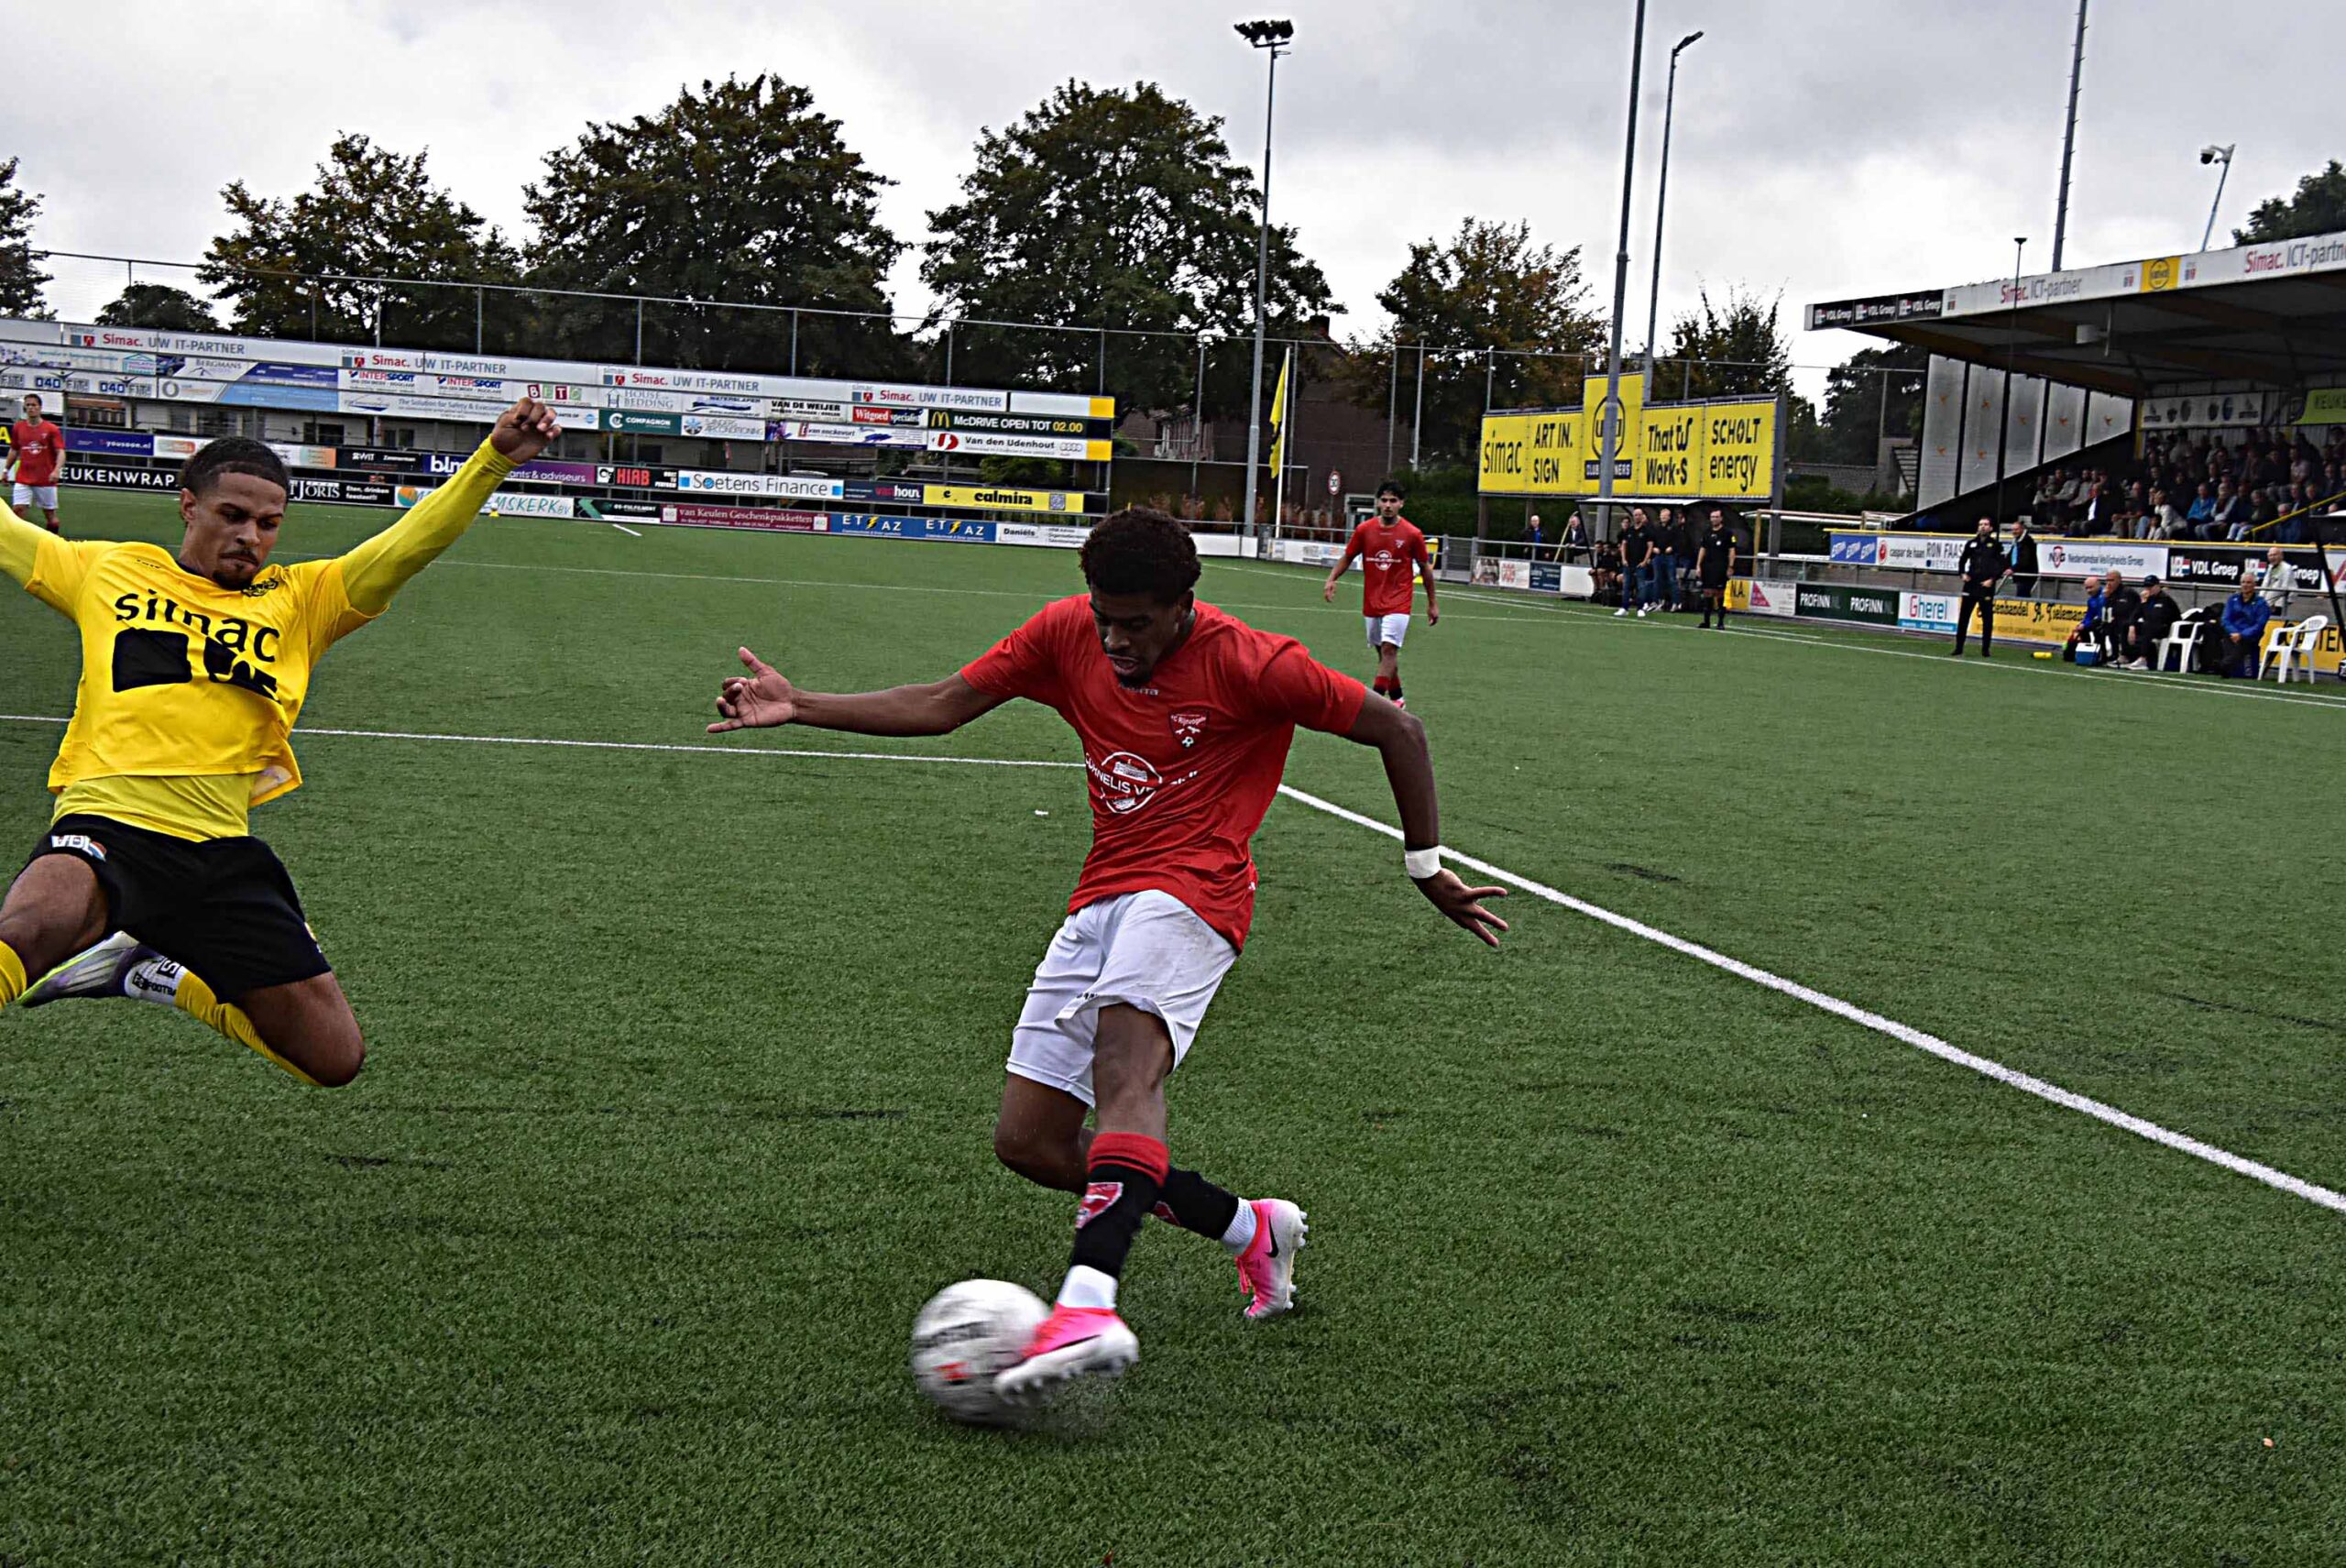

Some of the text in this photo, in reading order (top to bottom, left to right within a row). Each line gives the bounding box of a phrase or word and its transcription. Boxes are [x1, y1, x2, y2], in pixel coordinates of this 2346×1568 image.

[2030, 278, 2082, 301] ICT-partner
[103, 334, 246, 355] Simac. UW IT-PARTNER
[195, 358, 242, 370] BERGMANS
[372, 354, 507, 375] Simac. UW IT-PARTNER
[358, 370, 415, 383] INTERSPORT
[446, 377, 502, 389] INTERSPORT
[631, 372, 760, 392] Simac. UW IT-PARTNER
[623, 398, 674, 410] BEDDING
[771, 400, 791, 409] VAN
[806, 403, 841, 411] WEIJER
[880, 389, 1003, 408] Simac. UW IT-PARTNER
[625, 416, 671, 426] COMPAGNON
[854, 409, 889, 422] Witgoed
[954, 414, 1083, 433] McDRIVE OPEN TOT 02.00
[1533, 422, 1573, 449] ART IN.
[1648, 424, 1674, 452] That
[1711, 418, 1761, 445] SCHOLT
[965, 435, 1055, 449] Van den Udenhout
[1483, 429, 1522, 476] simac
[540, 472, 586, 483] adviseurs
[616, 467, 651, 486] HIAB
[1532, 457, 1560, 485] SIGN
[1709, 455, 1759, 492] energy
[693, 473, 828, 496] Soetens Finance
[974, 489, 1033, 506] calmira
[679, 508, 696, 516] van
[697, 508, 729, 519] Keulen
[729, 510, 812, 524] Geschenkpakketten
[1925, 542, 1964, 559] RON FAAS
[2191, 560, 2239, 580] VDL Groep
[1909, 595, 1948, 620] Gherel
[115, 588, 280, 663] simac
